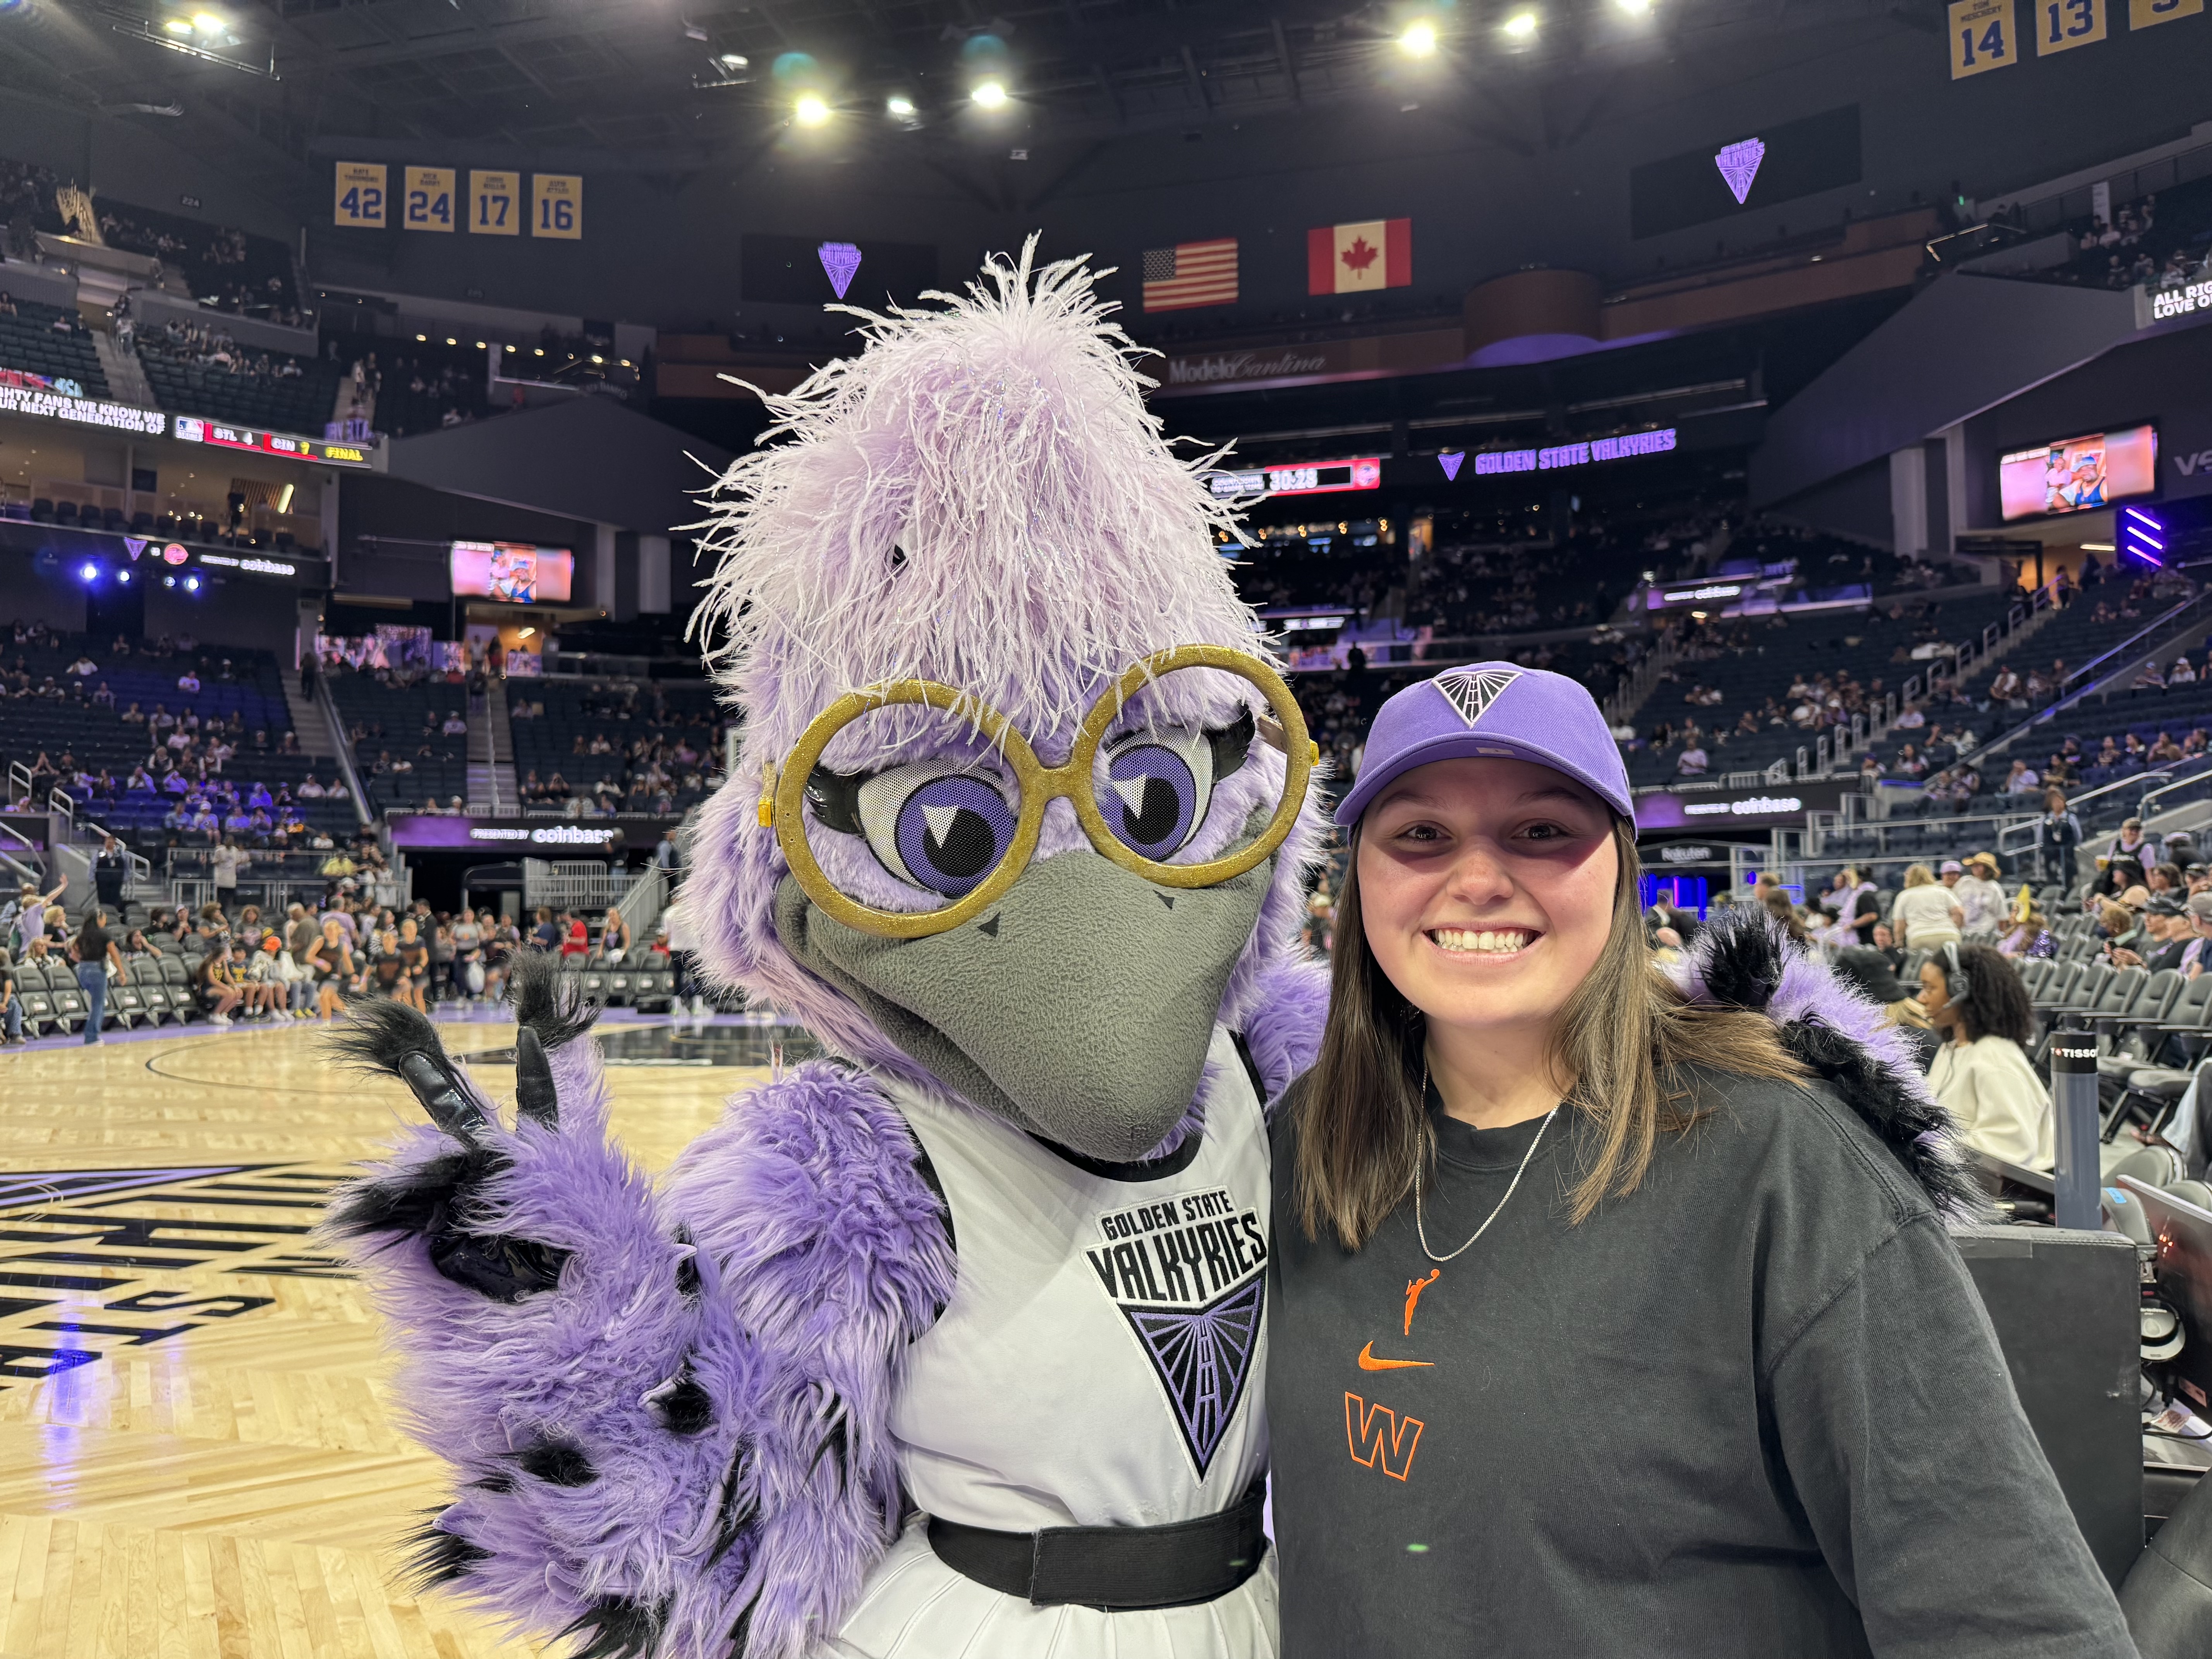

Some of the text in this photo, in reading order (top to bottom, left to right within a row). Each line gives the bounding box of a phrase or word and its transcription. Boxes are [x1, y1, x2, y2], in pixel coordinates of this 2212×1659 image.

[2048, 0, 2093, 43] 13
[1961, 20, 2005, 67] 14
[340, 187, 382, 220] 42
[409, 191, 450, 224] 24
[480, 195, 510, 227] 17
[541, 199, 573, 231] 16
[2154, 290, 2183, 307] ALL
[2154, 293, 2212, 319] LOVE O
[1169, 351, 1326, 384] Modelo Cantina
[0, 386, 166, 425] HTY FANS WE KNOW WE
[20, 400, 57, 416] NEXT
[58, 408, 144, 431] GENERATION
[146, 422, 166, 434] OF
[213, 428, 238, 441] STL
[271, 437, 295, 452] CIN
[1475, 428, 1676, 474] GOLDEN STATE VALKYRIES
[325, 447, 363, 461] FINAL
[1101, 1190, 1234, 1241] GOLDEN STATE
[1086, 1211, 1267, 1303] VALKYRIES
[1345, 1391, 1424, 1481] W
